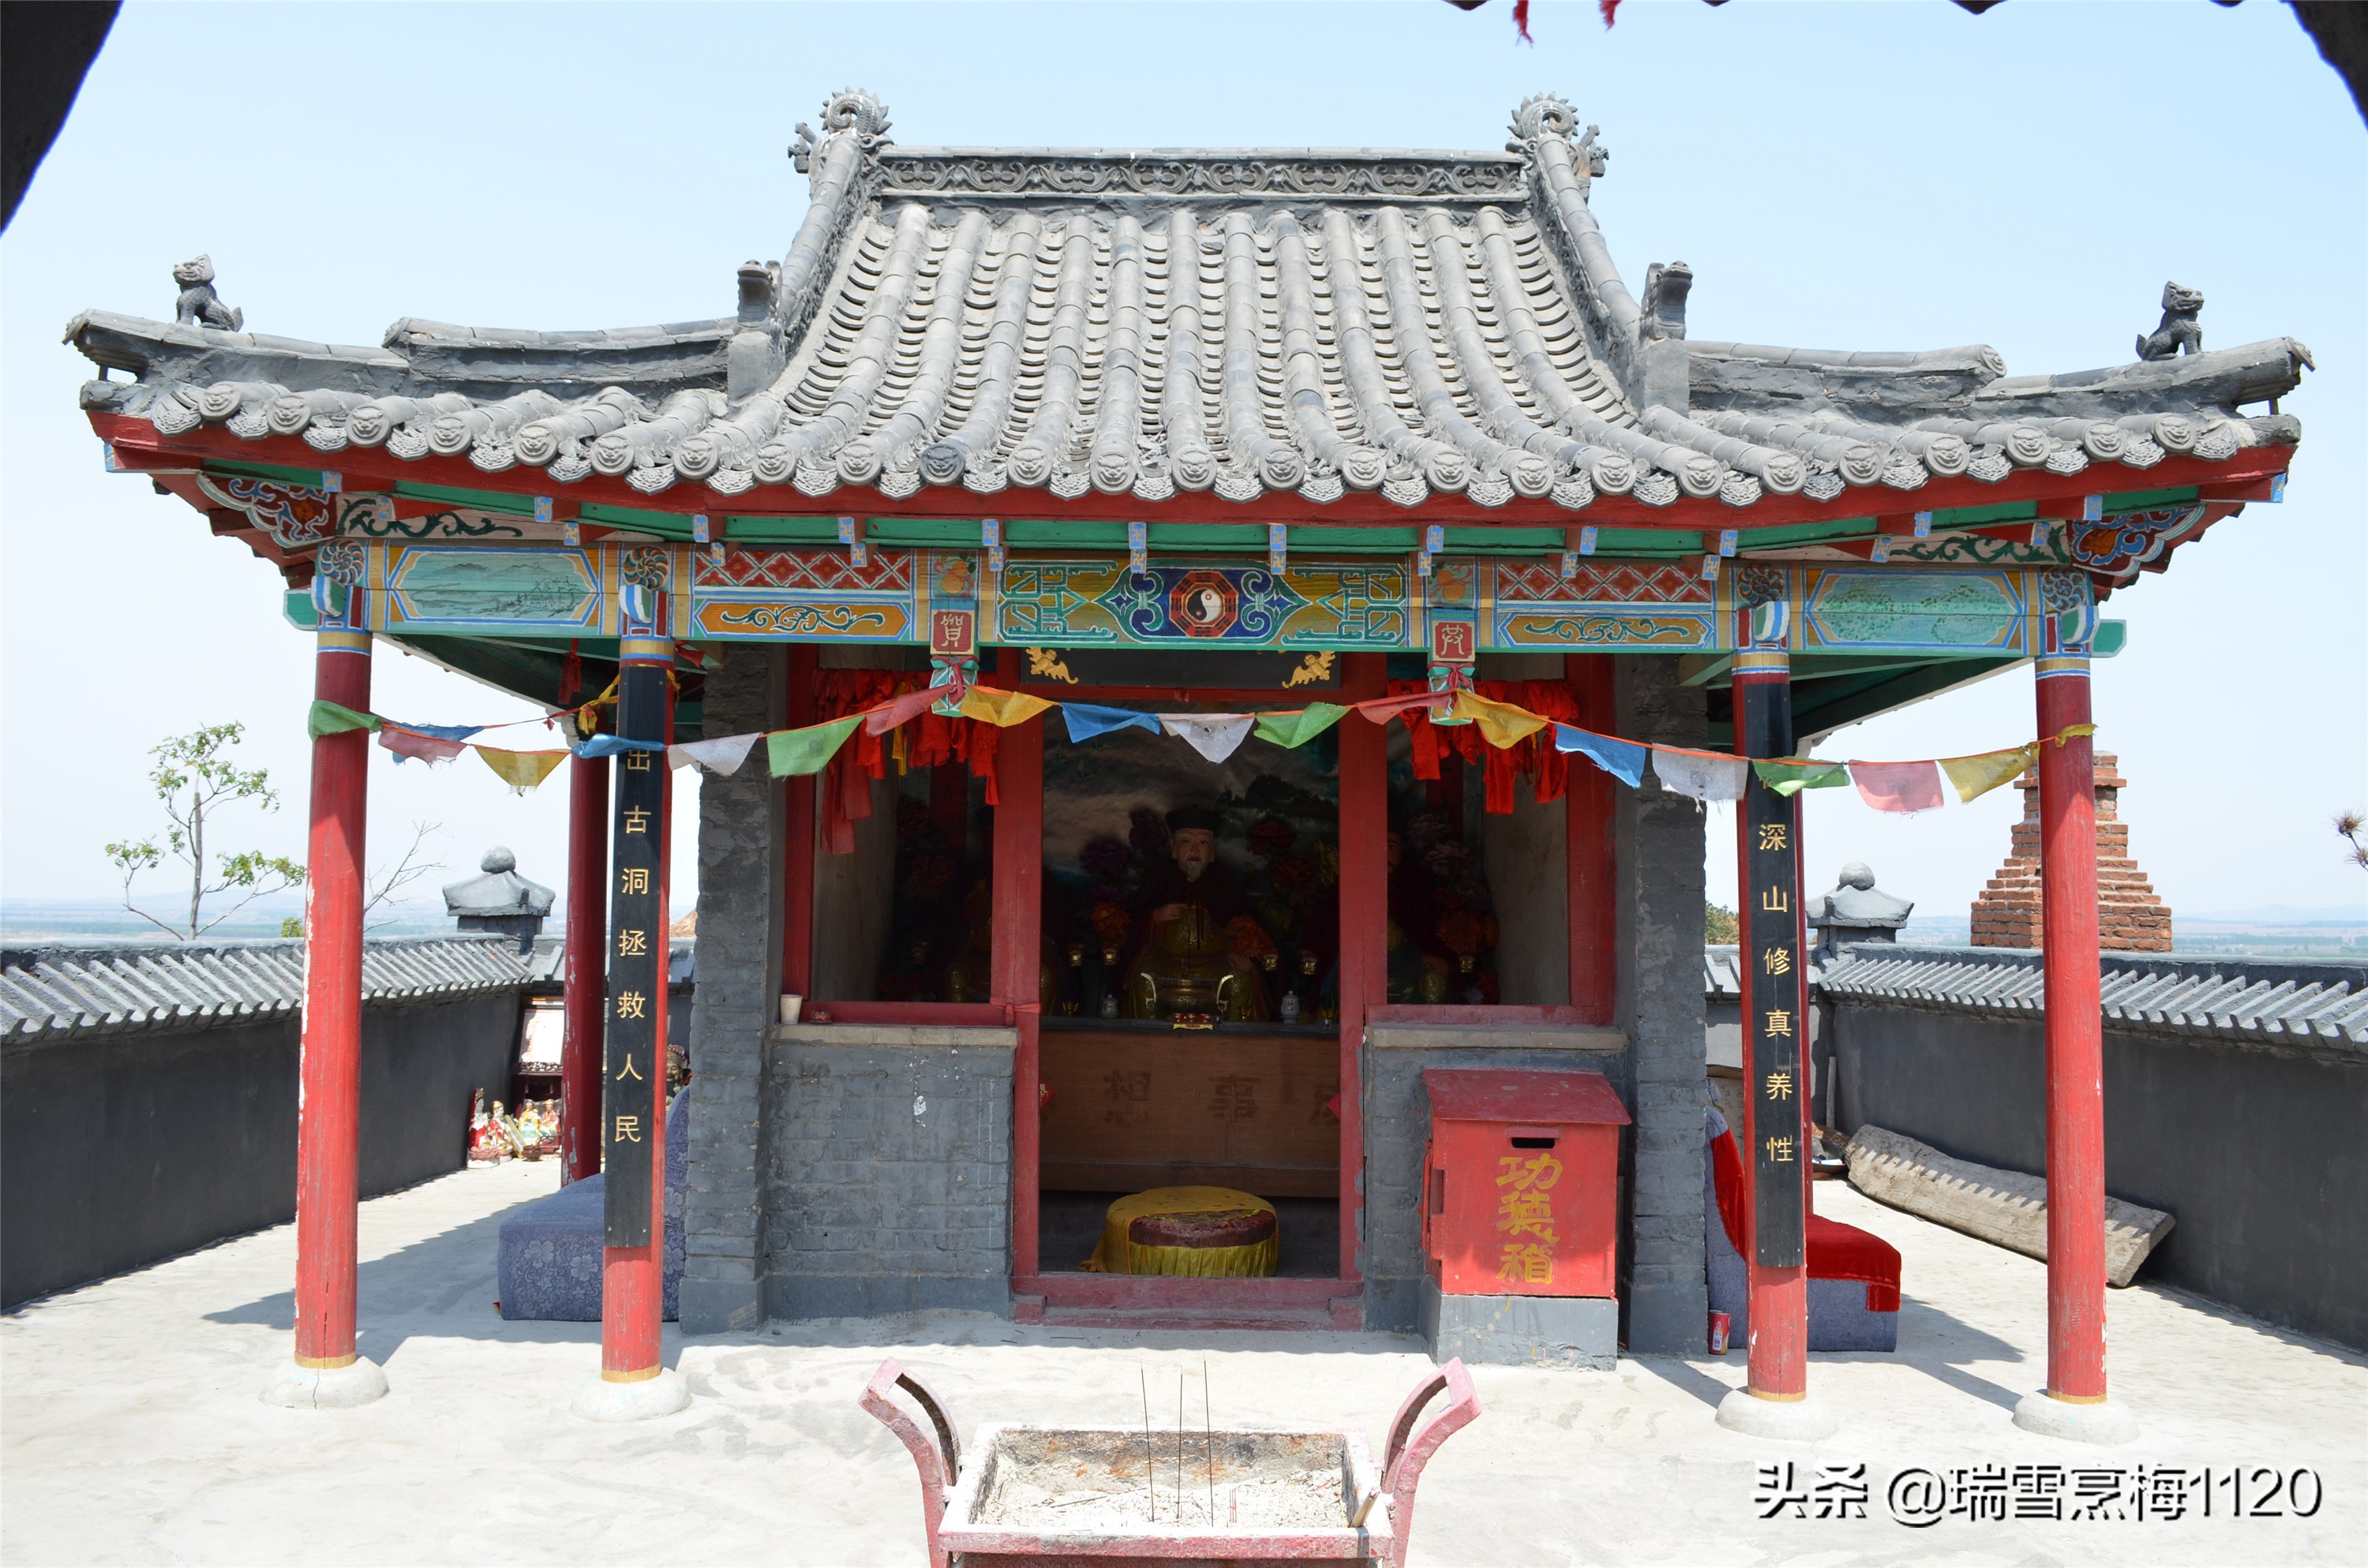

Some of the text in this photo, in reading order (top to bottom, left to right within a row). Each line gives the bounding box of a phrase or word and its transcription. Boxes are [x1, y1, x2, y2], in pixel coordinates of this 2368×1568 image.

[614, 748, 652, 1144] 出古洞拯救人民
[1759, 777, 1794, 1162] 深山修真养性
[1495, 1152, 1564, 1285] 功德箱
